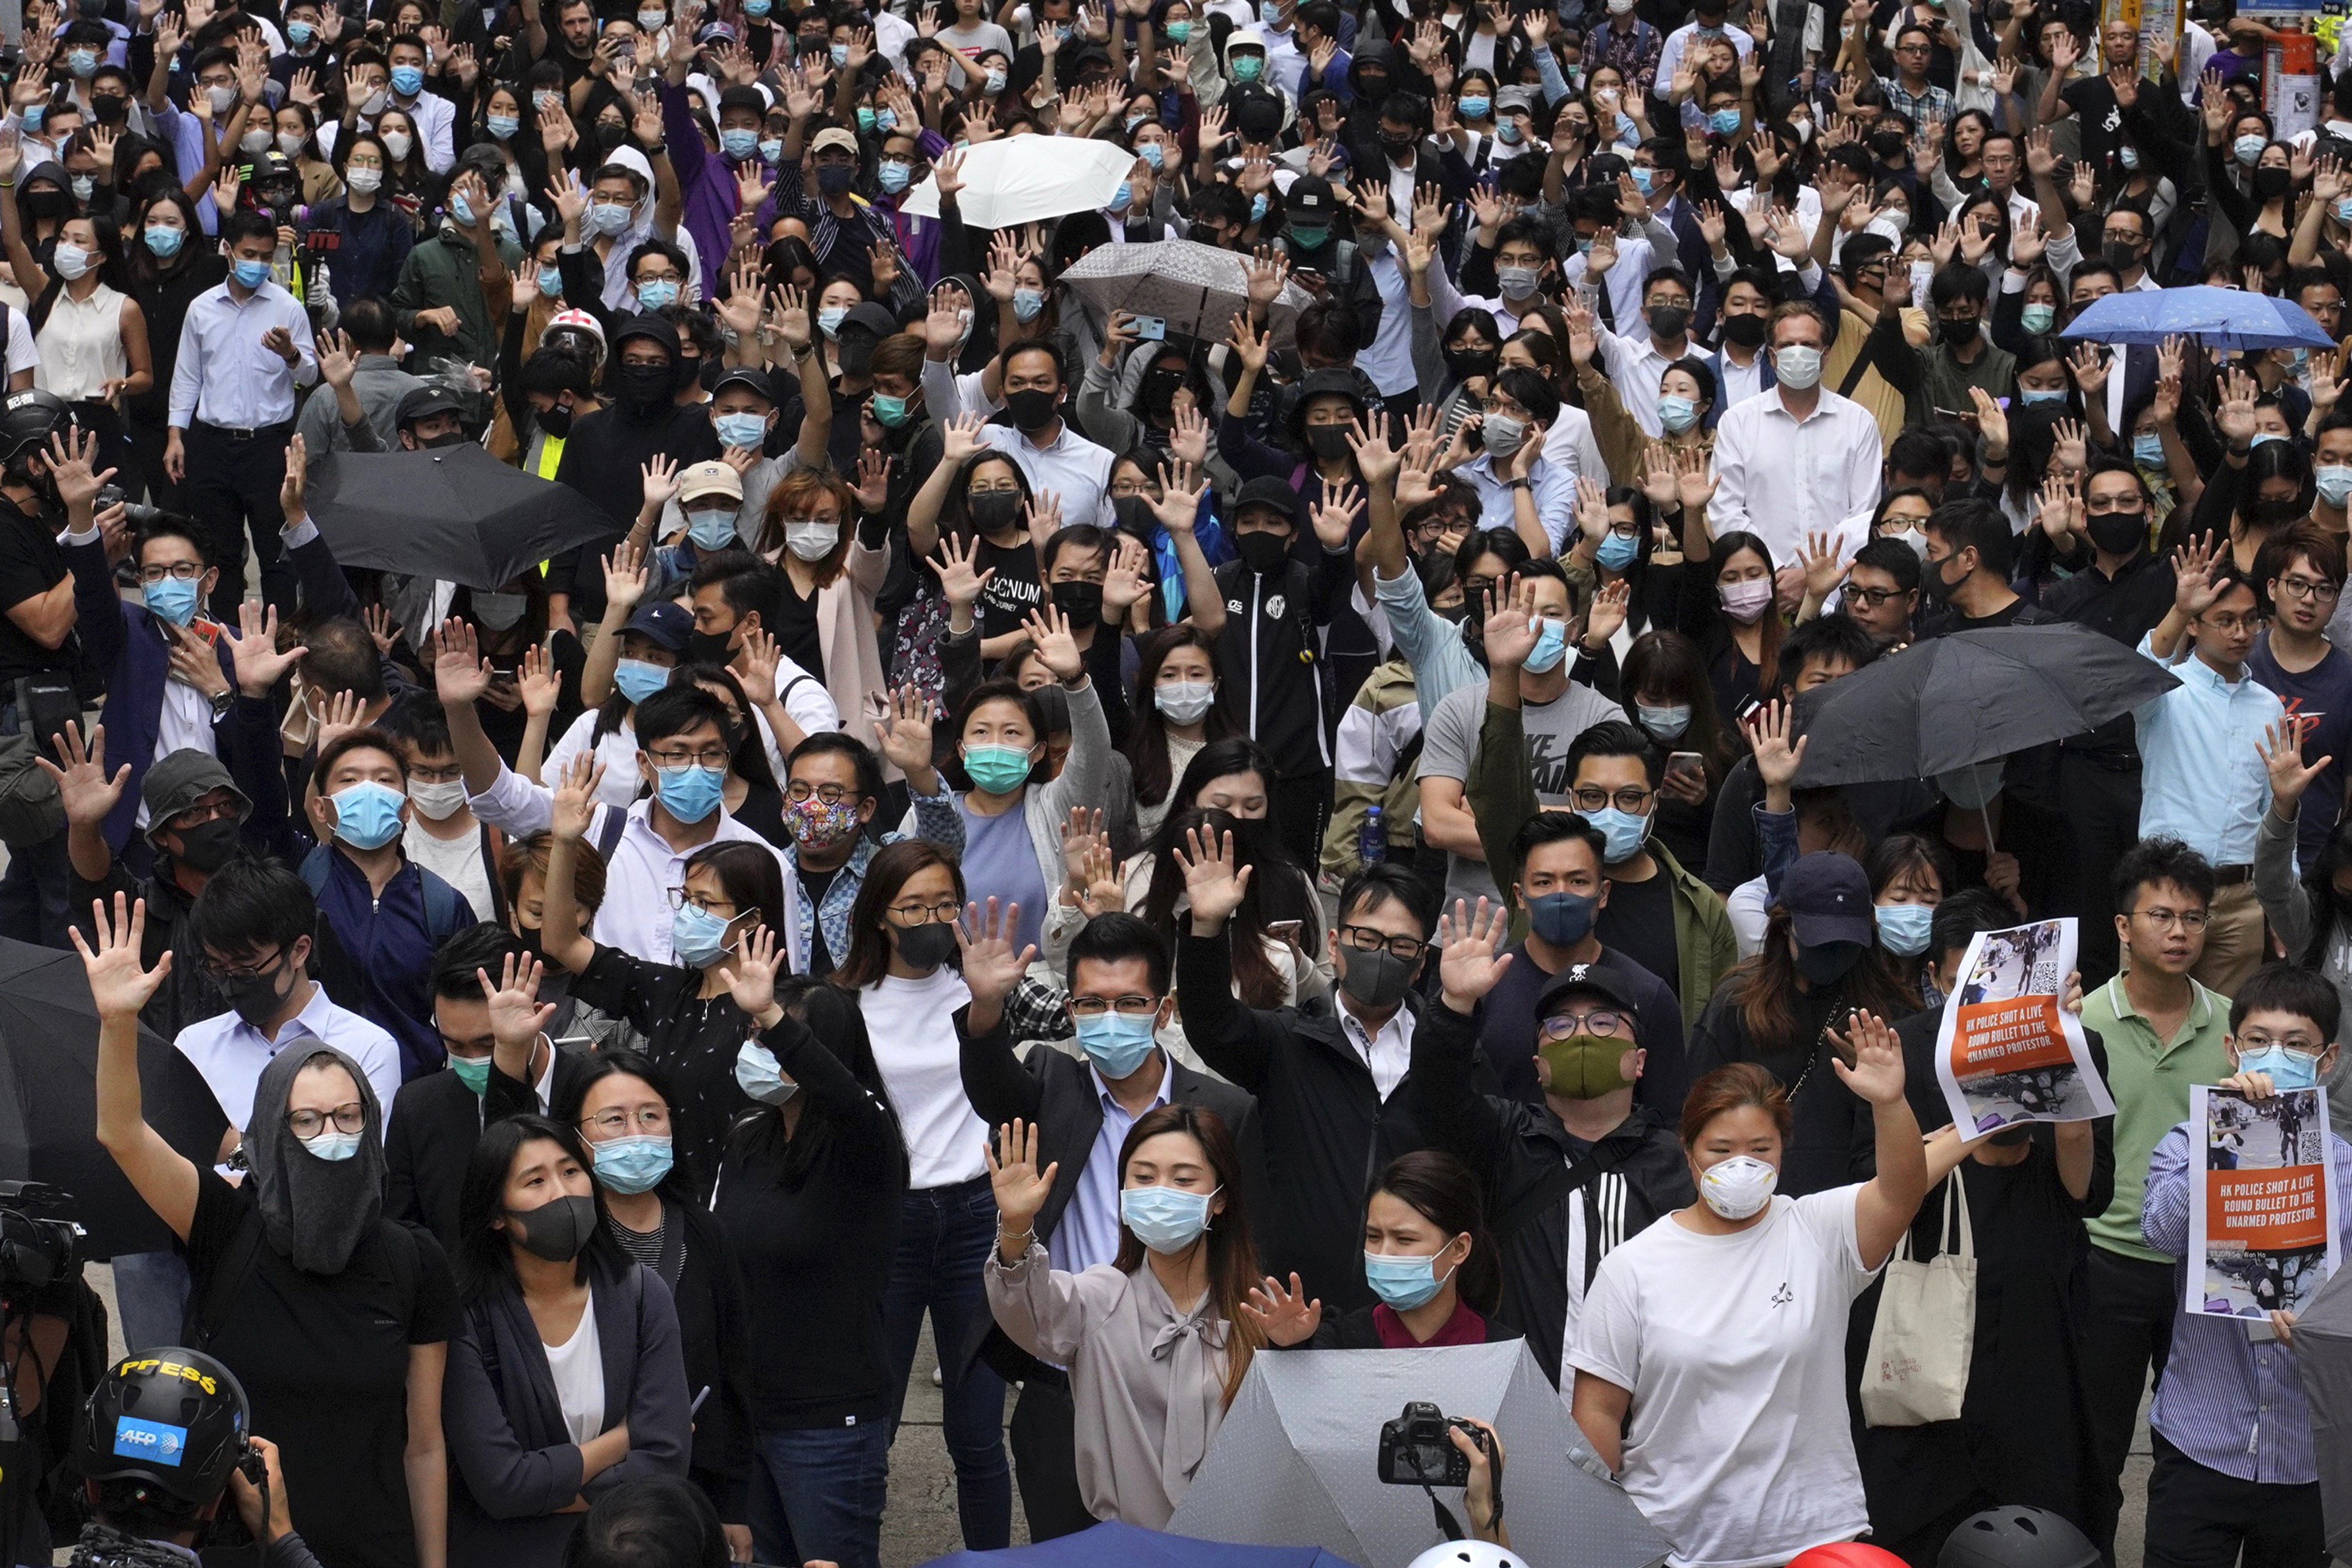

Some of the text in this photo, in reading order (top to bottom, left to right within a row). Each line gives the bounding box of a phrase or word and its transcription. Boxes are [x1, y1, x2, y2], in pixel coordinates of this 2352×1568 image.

[1524, 734, 1557, 758] KE
[1966, 1004, 2043, 1033] HK POLICE SHOT A LIVE
[1968, 1020, 2047, 1049] ROUND BULLET TO THE
[1967, 1035, 2054, 1063] UNARMED PROTESTOR.
[2220, 1174, 2314, 1197] HK POLICE SHOT A LIVE
[2224, 1190, 2315, 1212] ROUND BULLET TO THE
[2226, 1207, 2317, 1228] UNARMED PROTESTOR.
[119, 1430, 157, 1446] AFP
